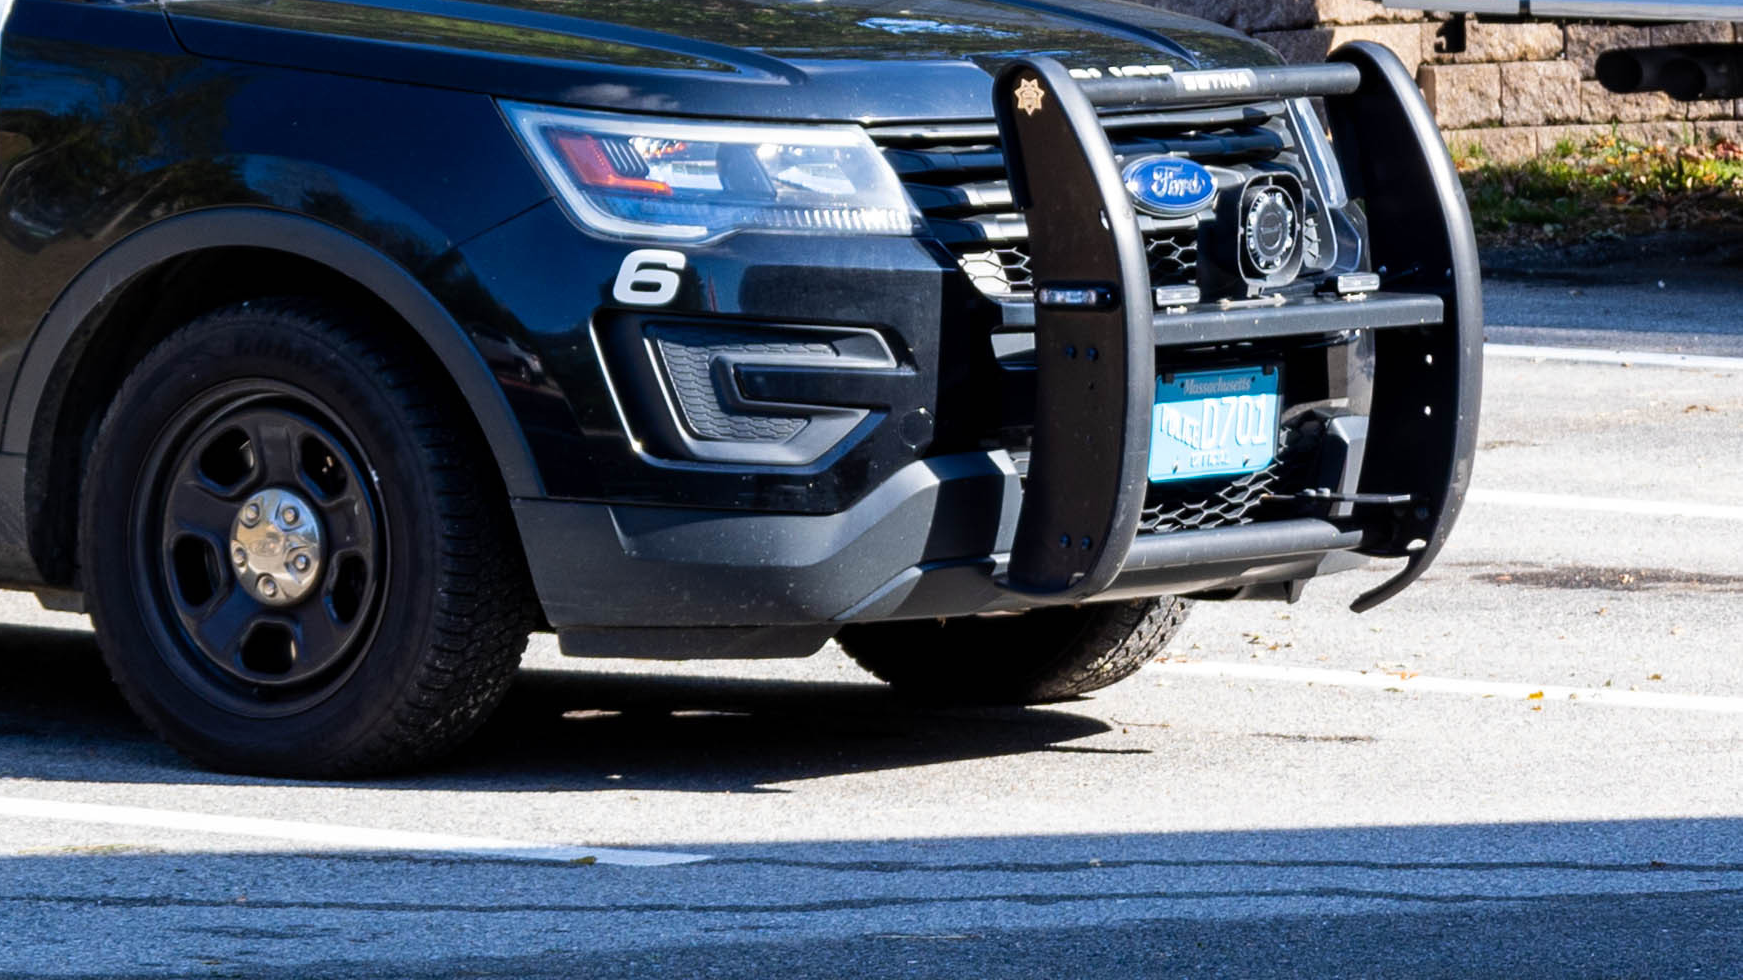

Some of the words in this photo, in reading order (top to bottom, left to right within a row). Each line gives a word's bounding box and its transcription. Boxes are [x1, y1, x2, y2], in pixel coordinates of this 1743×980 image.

[1151, 164, 1205, 197] Ford
[613, 249, 686, 306] 6
[1184, 377, 1252, 395] Massachusetts
[1201, 393, 1267, 450] D701
